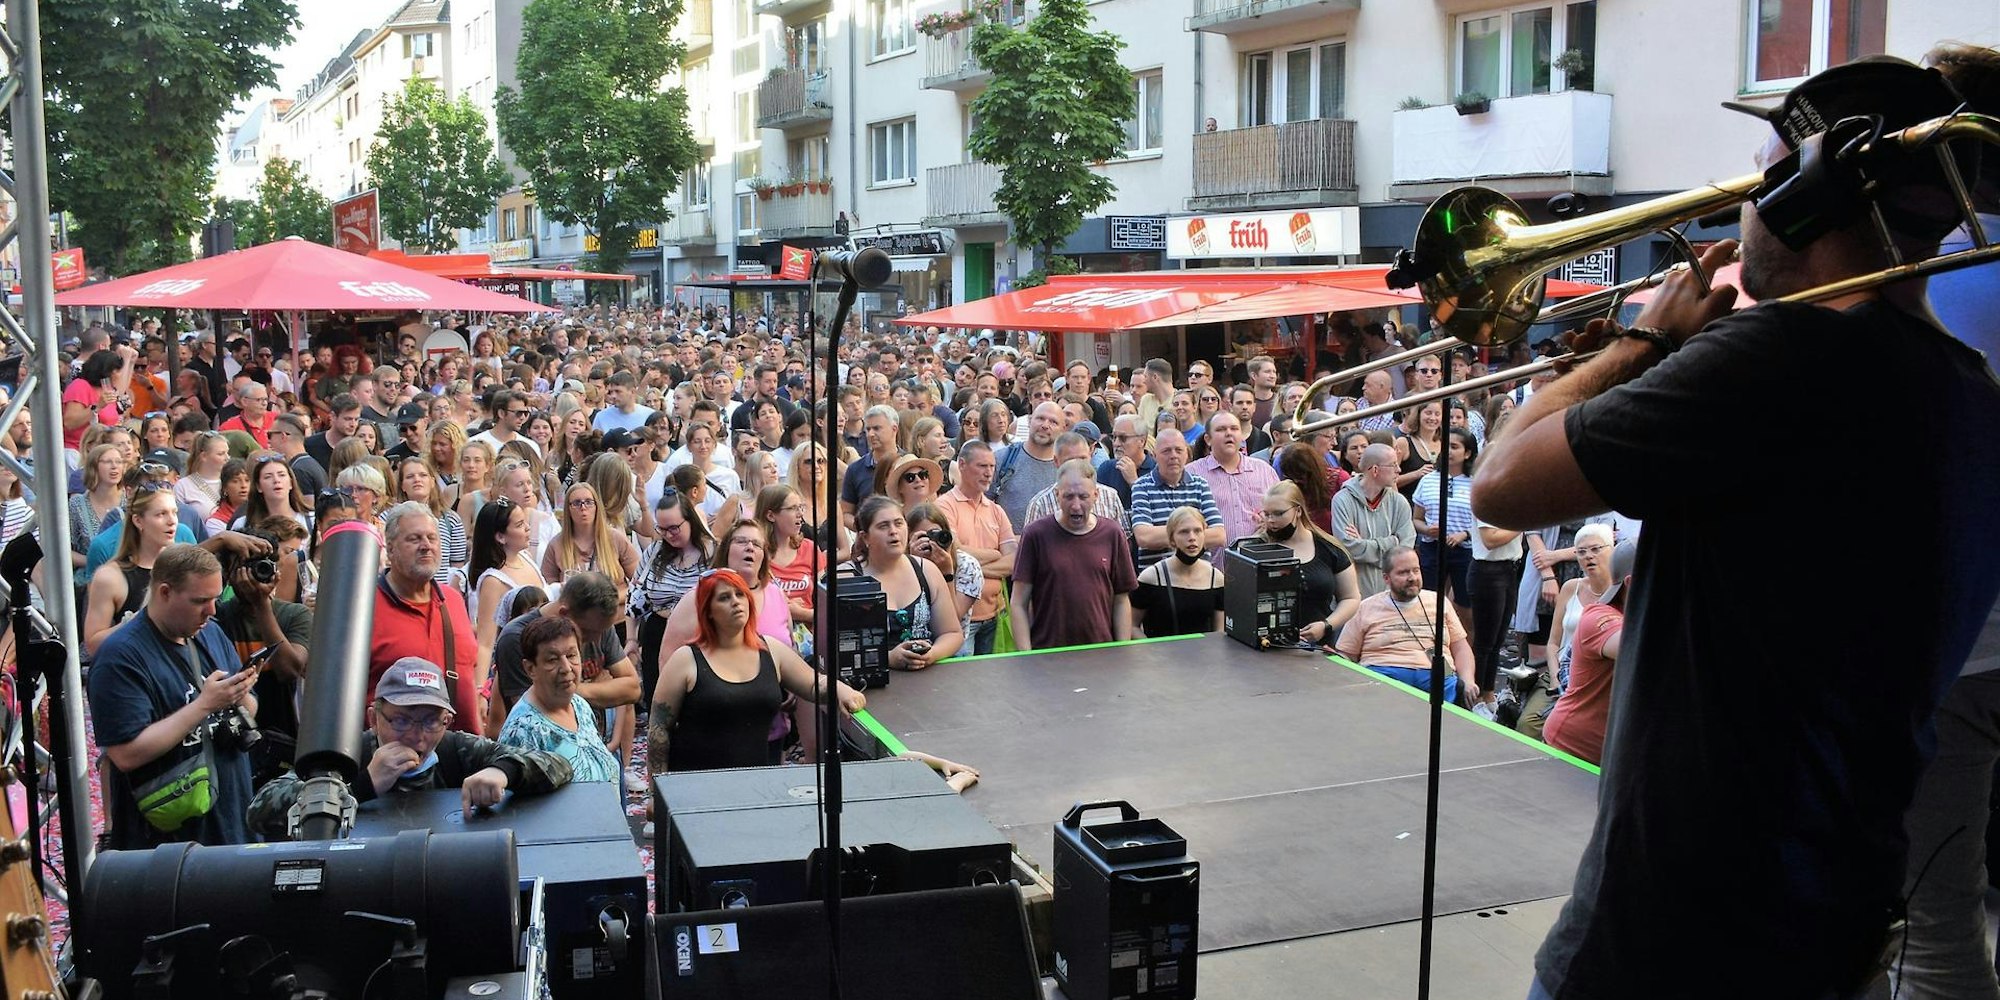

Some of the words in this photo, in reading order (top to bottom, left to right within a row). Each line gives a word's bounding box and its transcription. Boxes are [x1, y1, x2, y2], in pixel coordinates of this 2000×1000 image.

[1790, 106, 1808, 128] WITH
[1228, 217, 1269, 251] früh
[408, 672, 437, 681] HAMMER
[711, 928, 723, 947] 2
[677, 932, 691, 970] NEXO
